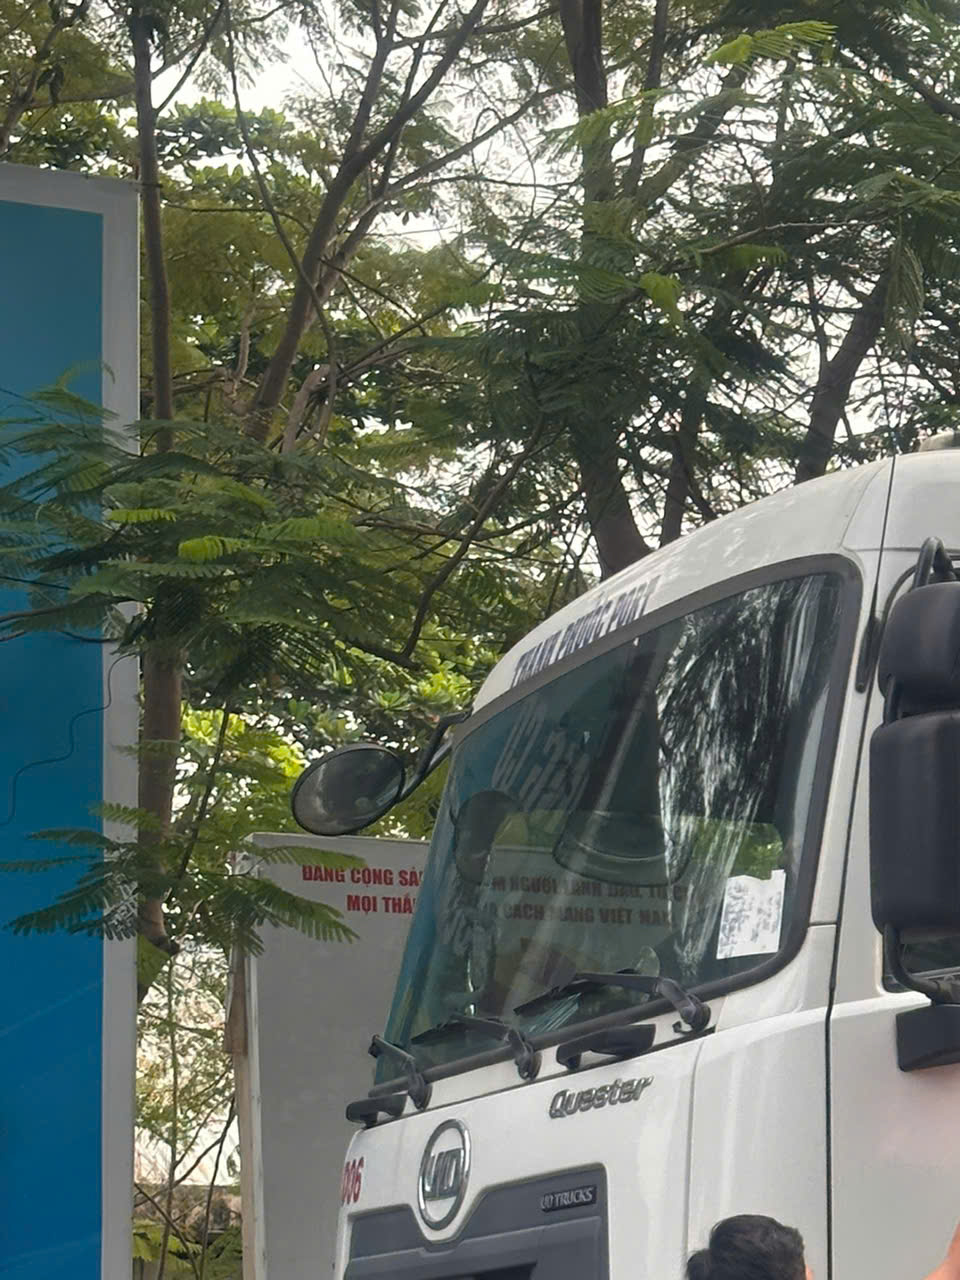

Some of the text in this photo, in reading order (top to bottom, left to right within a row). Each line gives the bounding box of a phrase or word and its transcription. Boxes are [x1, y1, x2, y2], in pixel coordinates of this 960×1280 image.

[398, 866, 423, 887] SẢ
[347, 894, 378, 915] MỌI
[549, 1076, 655, 1119] Quester
[554, 1187, 594, 1207] TRUCKS
